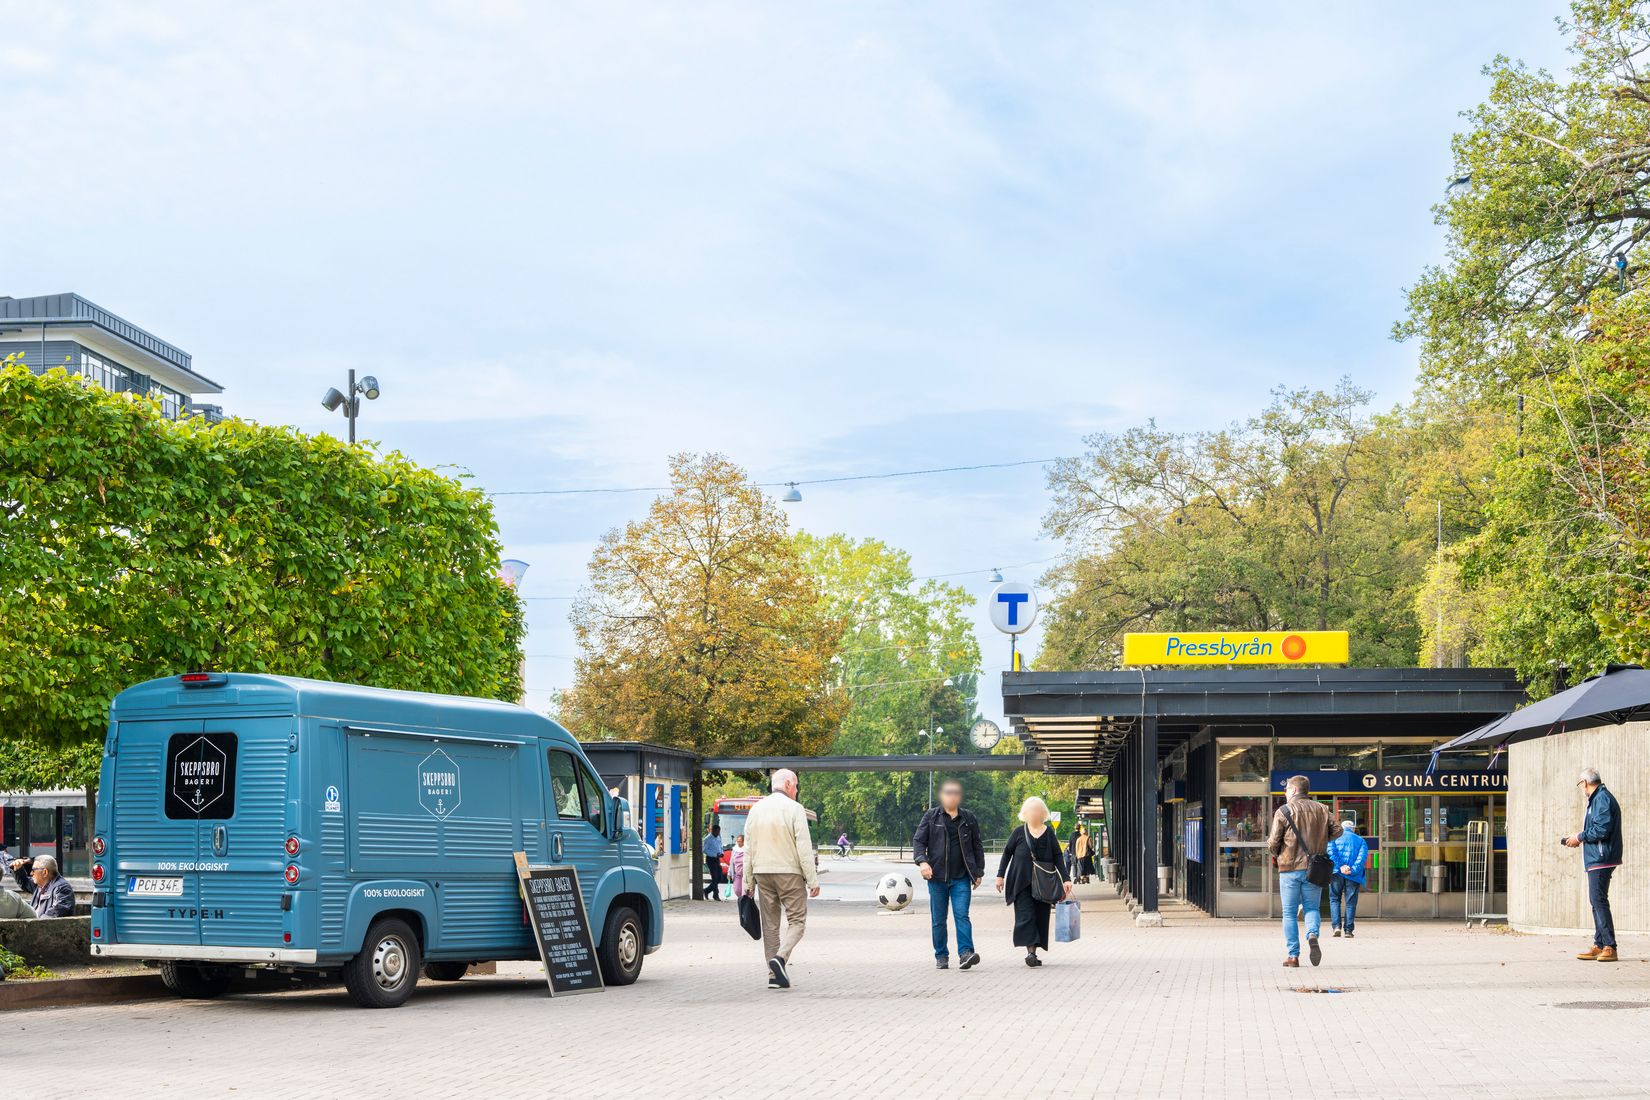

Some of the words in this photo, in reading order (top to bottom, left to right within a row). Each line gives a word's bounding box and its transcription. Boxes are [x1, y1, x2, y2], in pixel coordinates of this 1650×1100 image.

[997, 593, 1029, 626] T
[1165, 637, 1272, 661] Pressbyrån
[180, 761, 220, 776] SKEPPSBRO
[422, 772, 456, 786] SKEPPSBRO
[1384, 775, 1434, 787] SOLNA
[157, 862, 177, 871] 100%
[178, 862, 229, 872] EKOLOGISKT
[137, 879, 158, 892] PCH
[363, 889, 382, 898] 100%
[383, 889, 425, 898] EKOLOGISKT
